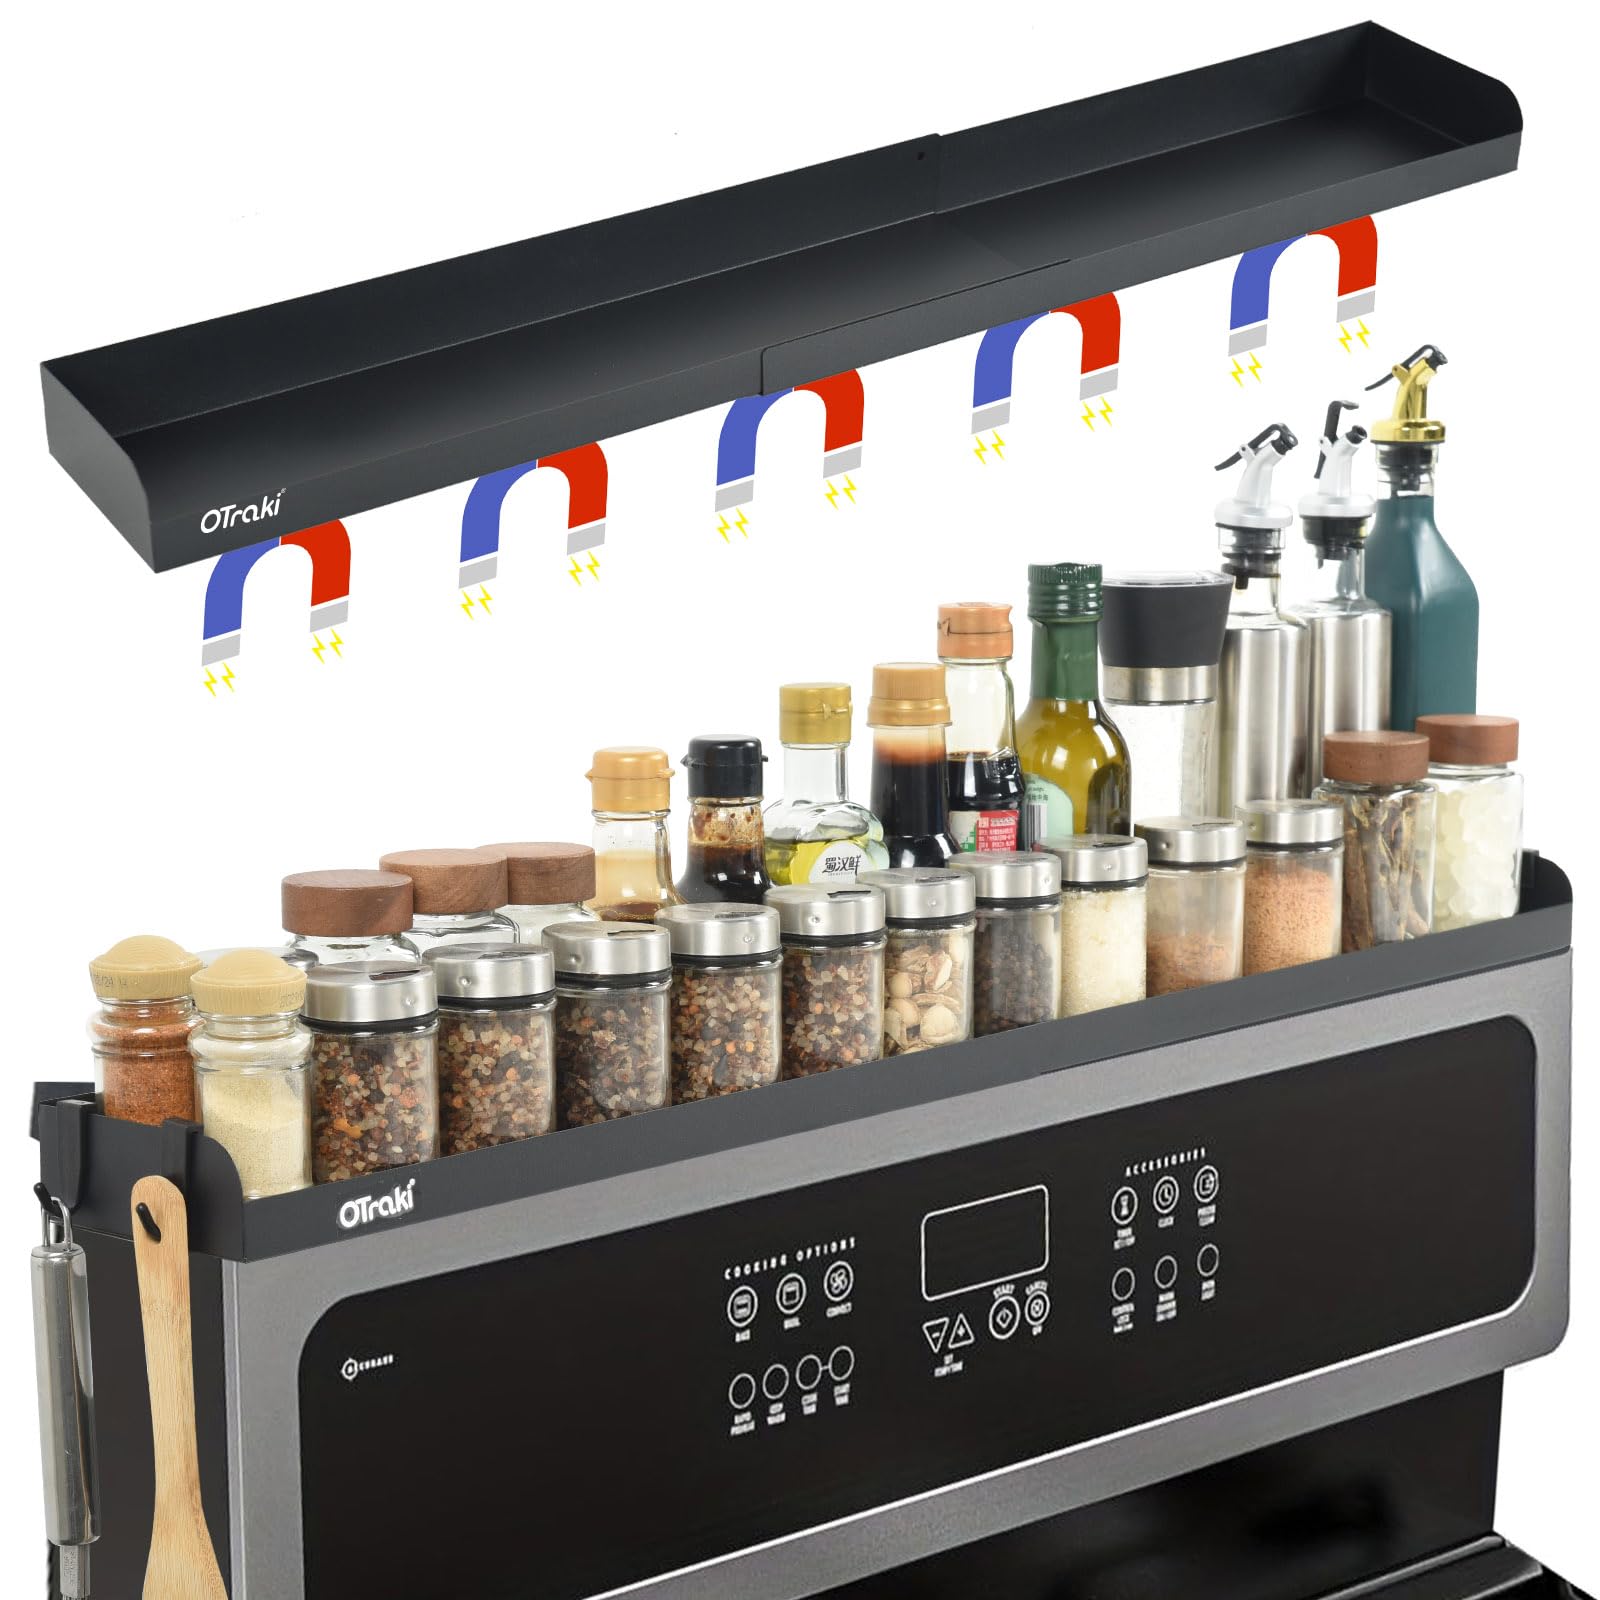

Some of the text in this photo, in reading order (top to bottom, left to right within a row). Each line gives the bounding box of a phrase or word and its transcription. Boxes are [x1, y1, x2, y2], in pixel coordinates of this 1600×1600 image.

[822, 854, 861, 876] 蜀汉鲜
[1125, 1147, 1206, 1177] ACCESSORIES
[724, 1236, 856, 1280] COOKING OPTIONS
